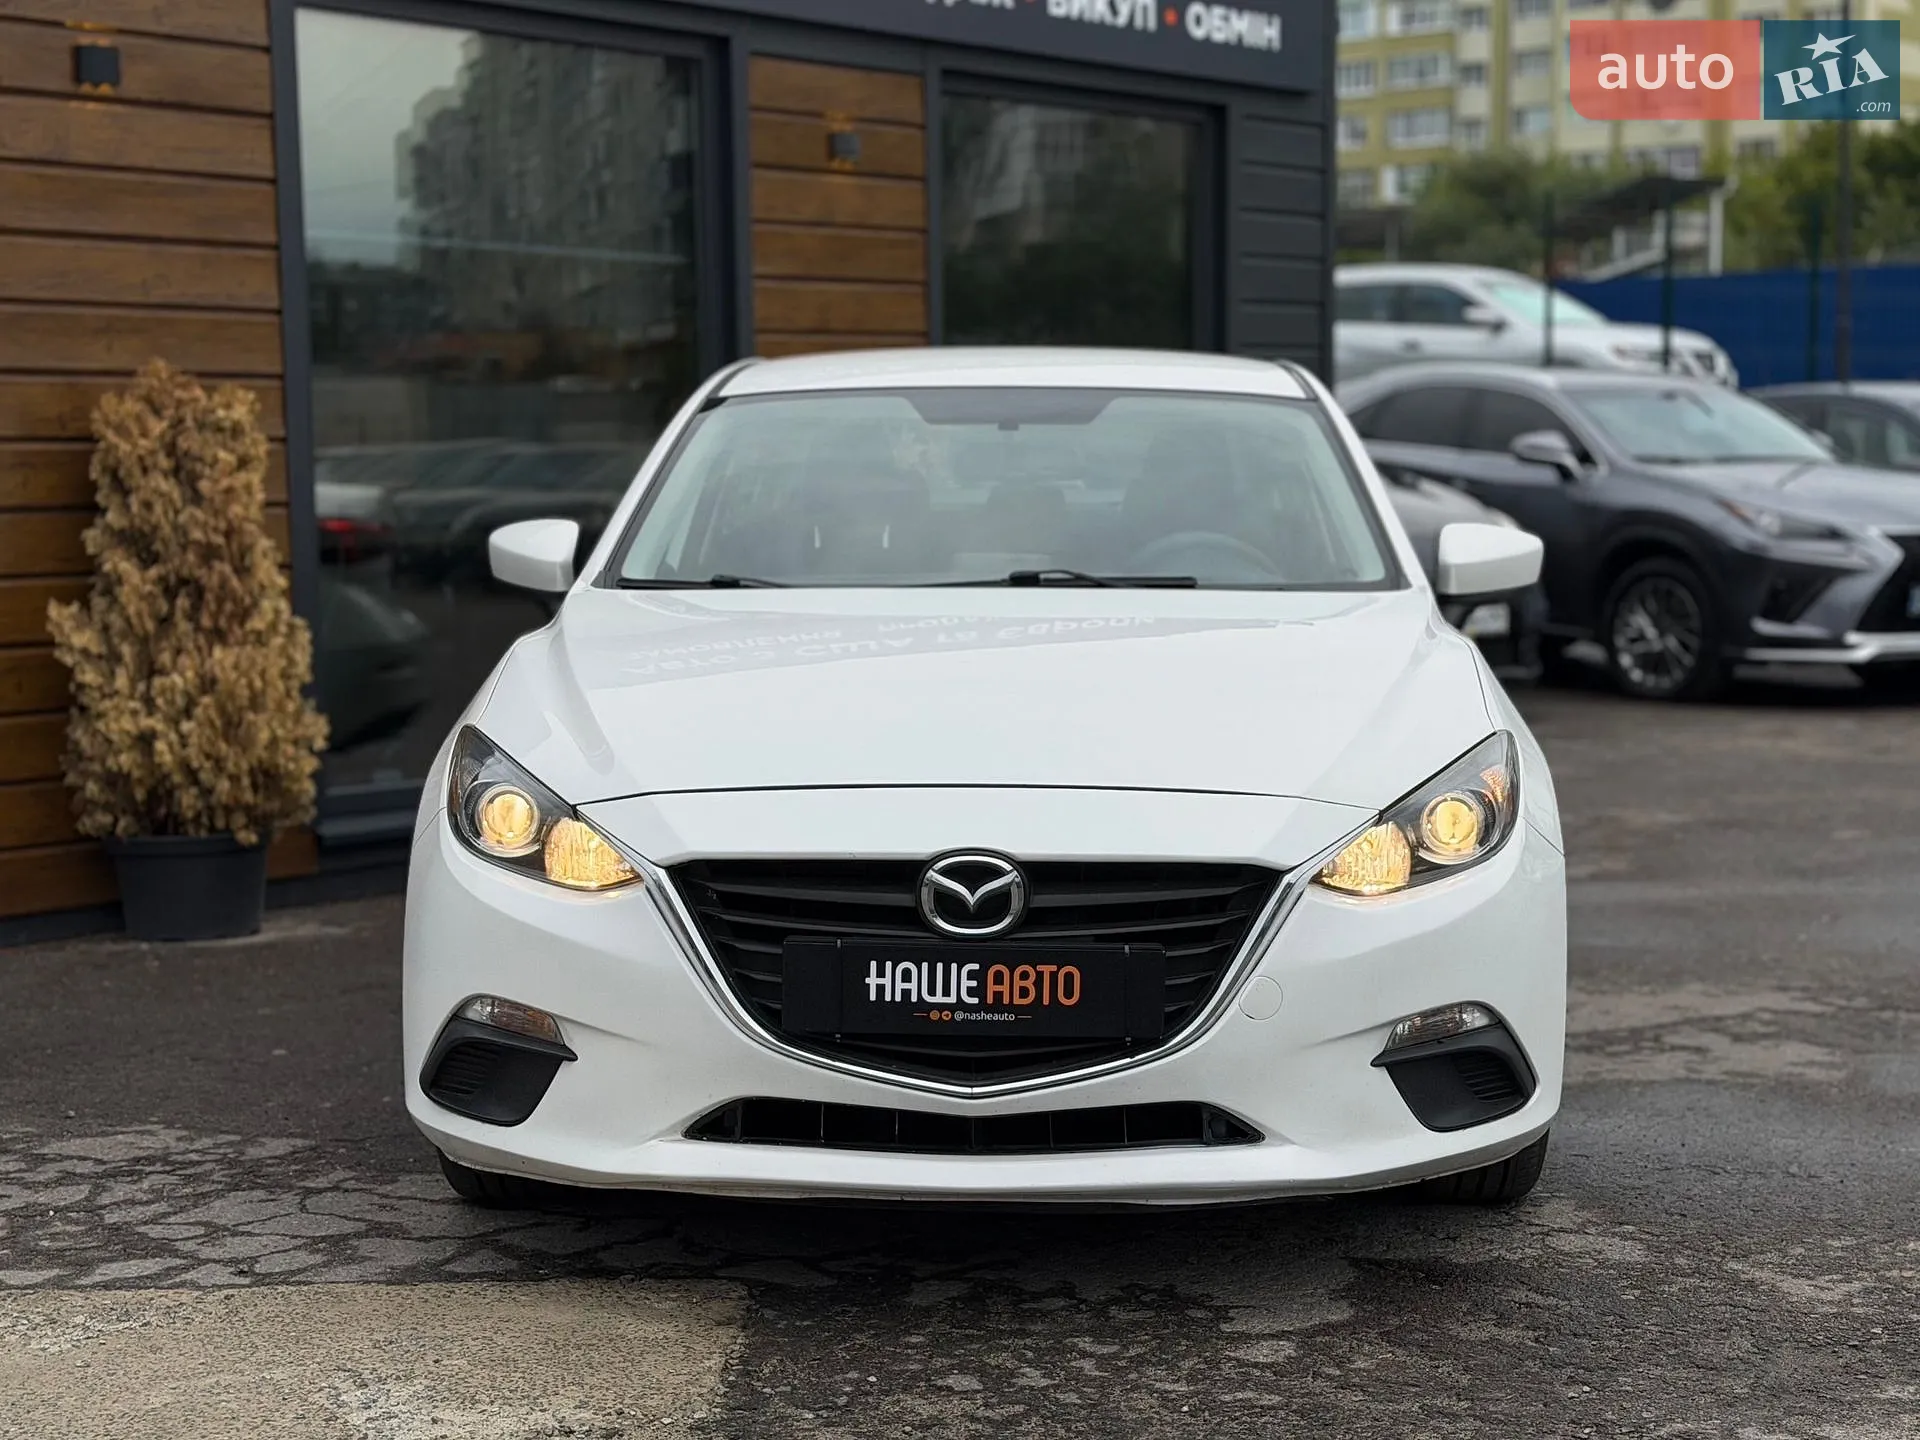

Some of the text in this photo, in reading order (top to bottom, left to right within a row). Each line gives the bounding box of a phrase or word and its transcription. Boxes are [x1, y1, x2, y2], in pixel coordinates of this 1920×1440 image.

[1184, 6, 1282, 51] ОБМІН
[865, 960, 1080, 1006] НАШЕ АВТО
[954, 1010, 1015, 1021] @nasheauto
